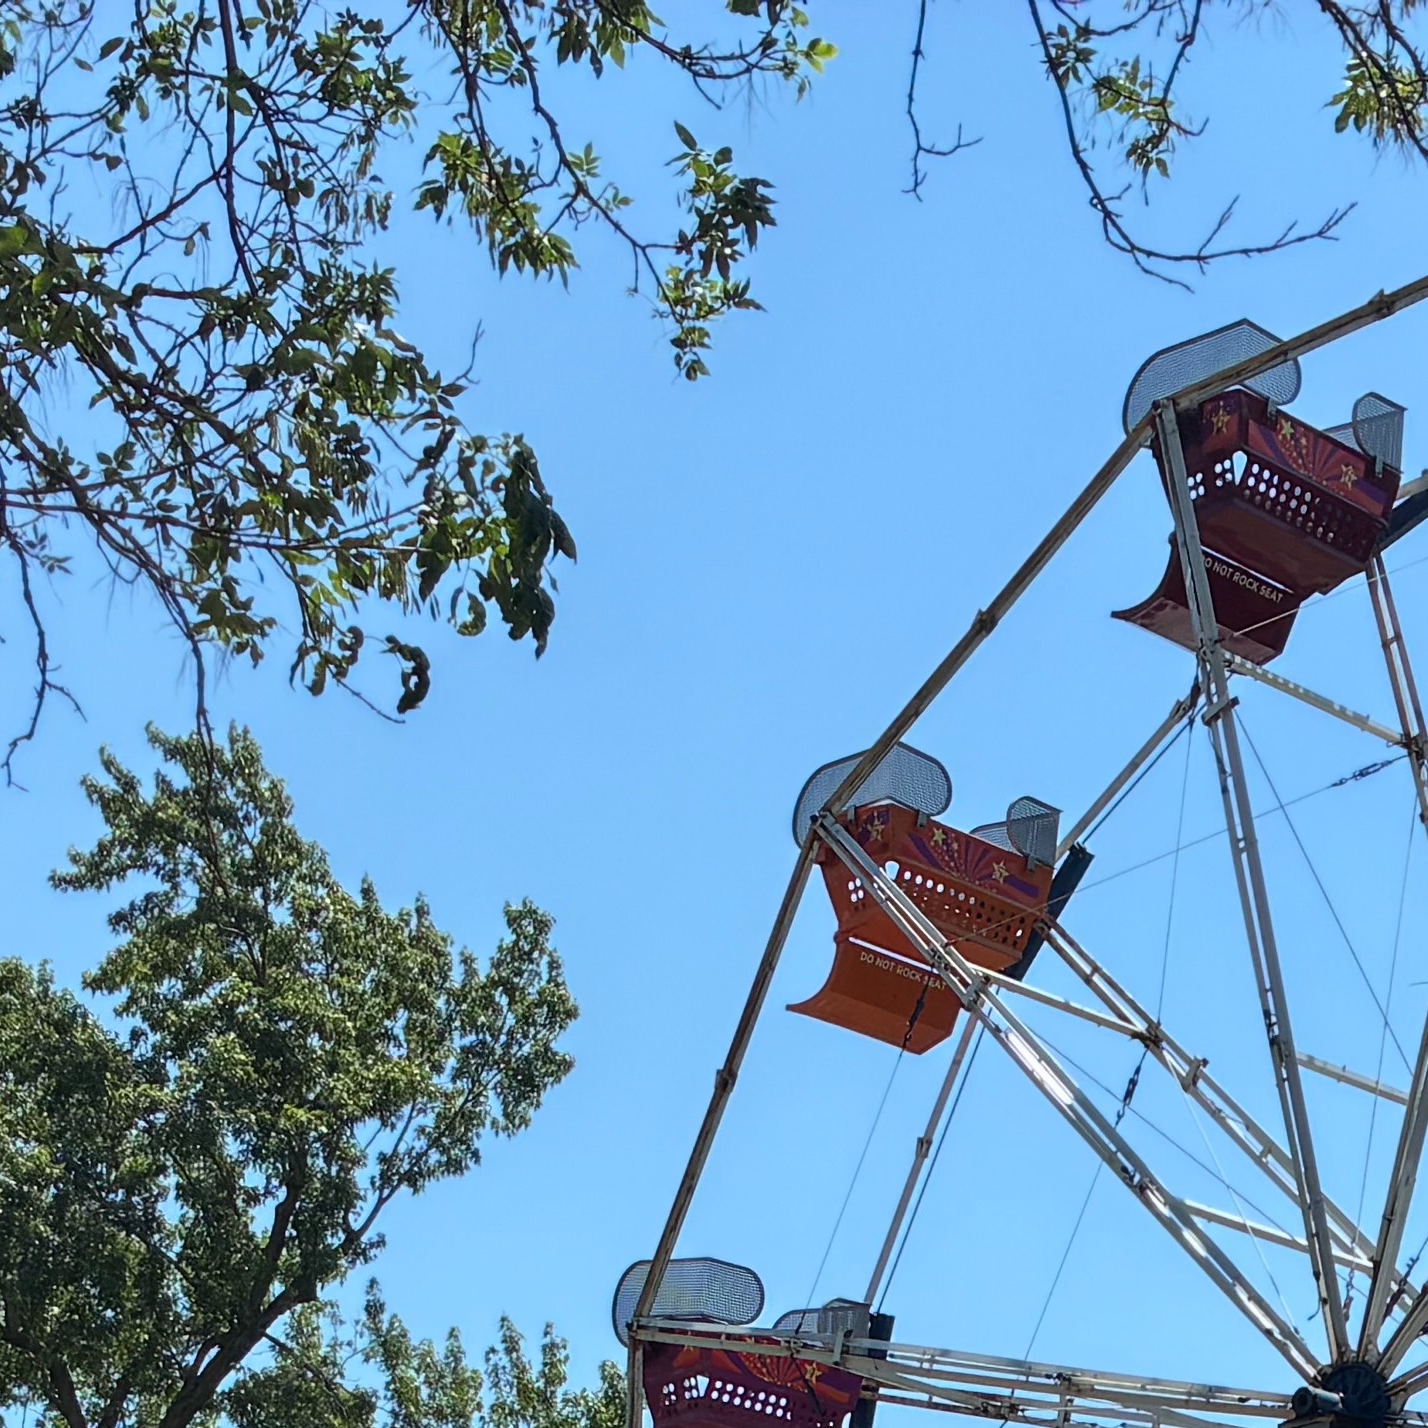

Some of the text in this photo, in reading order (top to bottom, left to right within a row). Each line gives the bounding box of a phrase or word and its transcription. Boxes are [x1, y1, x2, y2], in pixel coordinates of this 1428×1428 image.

[1212, 560, 1234, 579] NOT
[1232, 572, 1260, 593] ROCK
[1259, 585, 1284, 604] SEAT
[860, 951, 947, 990] DO NOT ROCK SEAT
